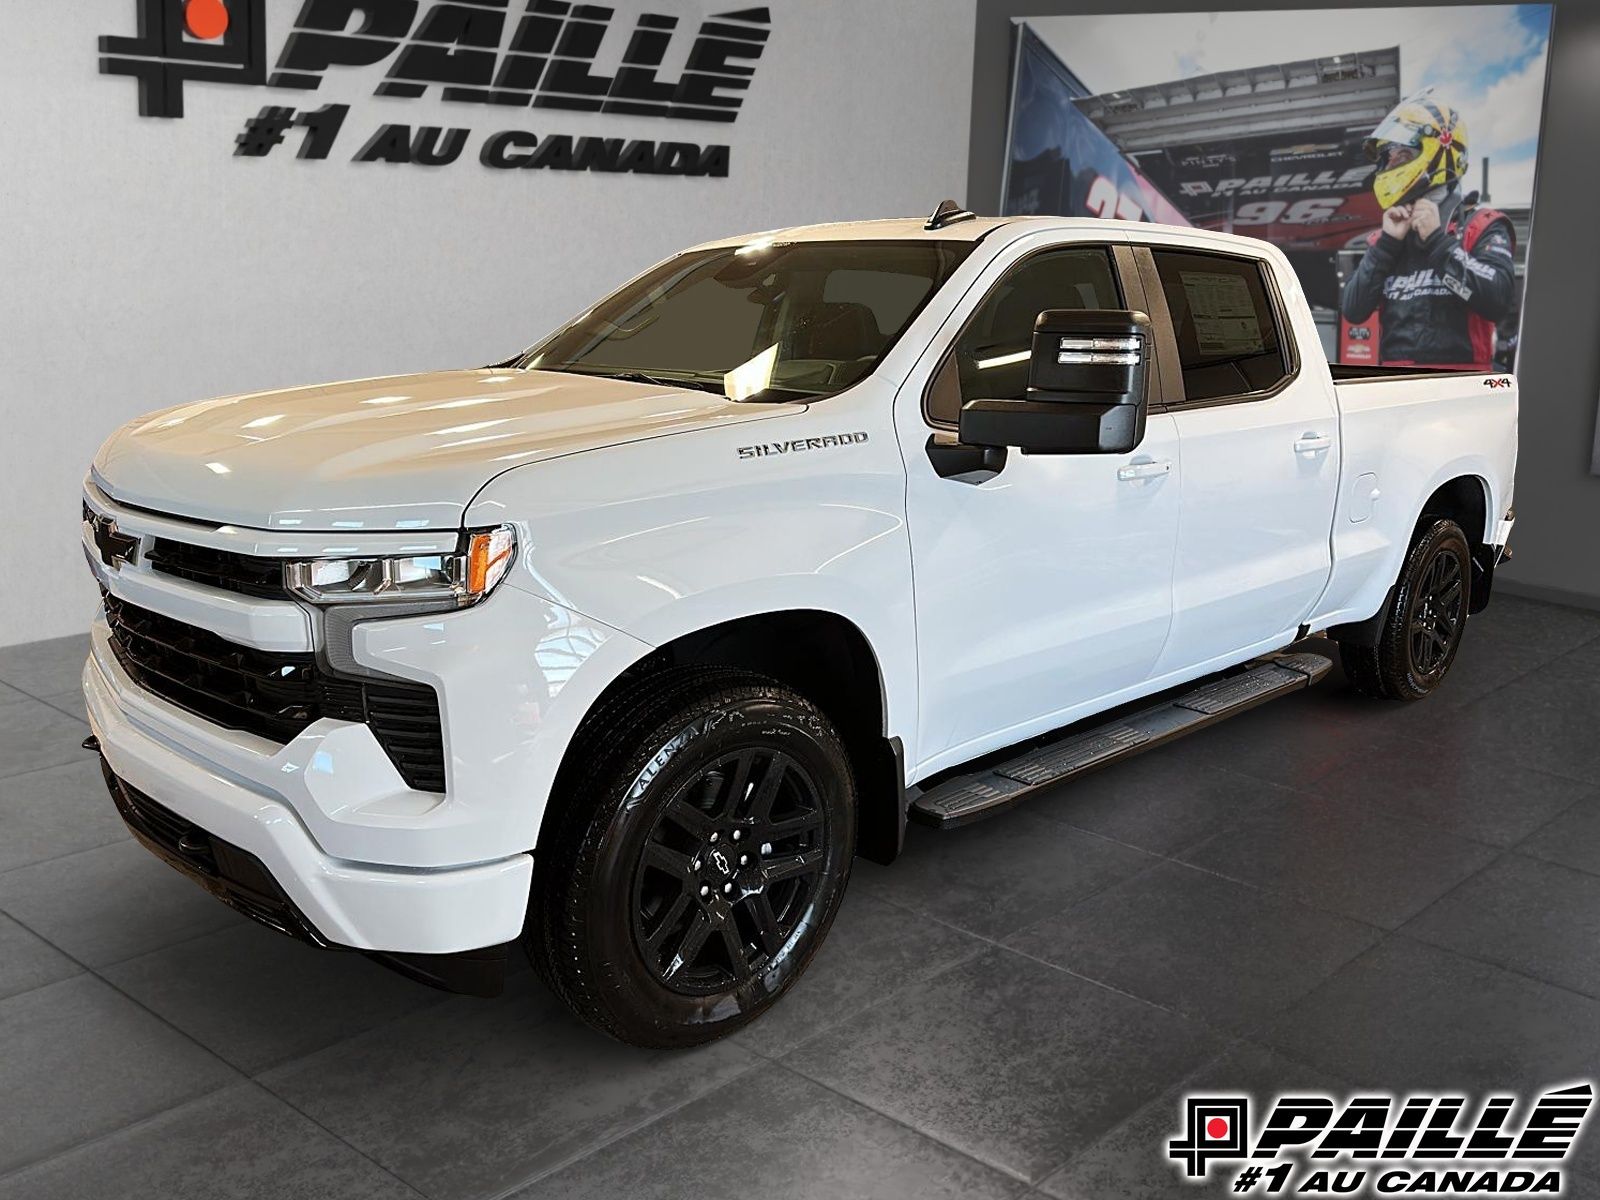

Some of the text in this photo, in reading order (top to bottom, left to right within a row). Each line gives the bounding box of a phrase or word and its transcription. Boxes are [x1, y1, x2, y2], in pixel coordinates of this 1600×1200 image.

[266, 0, 772, 123] PAILLÉ
[233, 104, 731, 178] #1 AU CANADA
[1270, 151, 1344, 163] CHEVROLET
[1239, 188, 1266, 196] AU
[1273, 182, 1364, 194] CANADA
[1233, 198, 1345, 225] 96
[736, 431, 869, 459] SILVERADO
